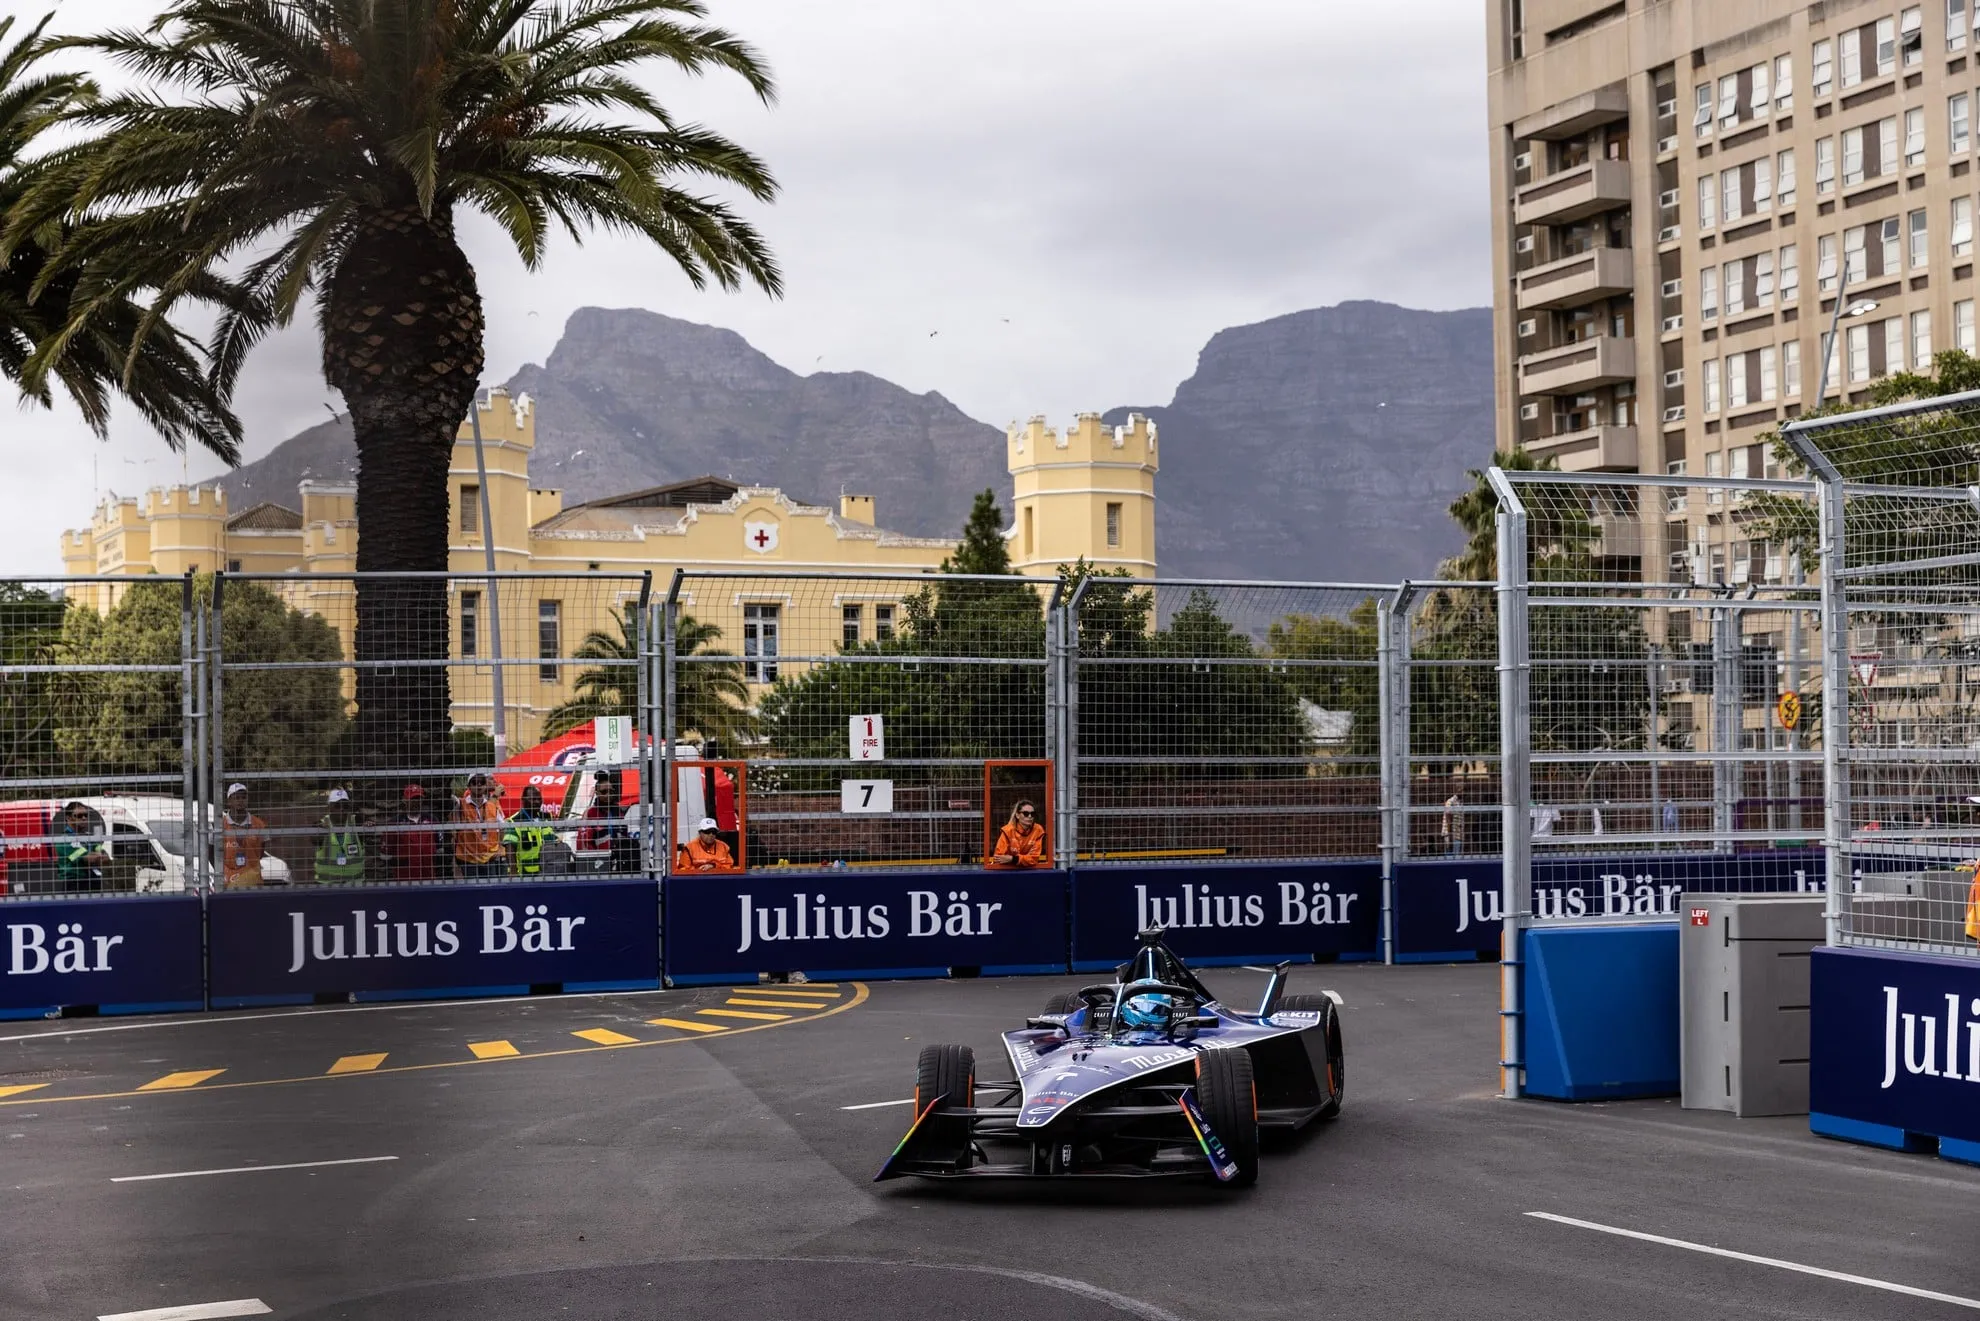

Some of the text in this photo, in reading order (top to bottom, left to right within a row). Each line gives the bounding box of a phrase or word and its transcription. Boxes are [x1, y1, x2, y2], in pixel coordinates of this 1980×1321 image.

[608, 741, 618, 750] EXIT
[862, 738, 878, 747] FIRE
[861, 785, 874, 808] 7
[1134, 881, 1358, 940] Julius Bär
[1600, 873, 1682, 917] Bär
[1691, 909, 1709, 918] LEFT
[288, 904, 586, 973] Julius Bär
[736, 890, 1002, 953] Julius Bär
[7, 923, 124, 975] Bär
